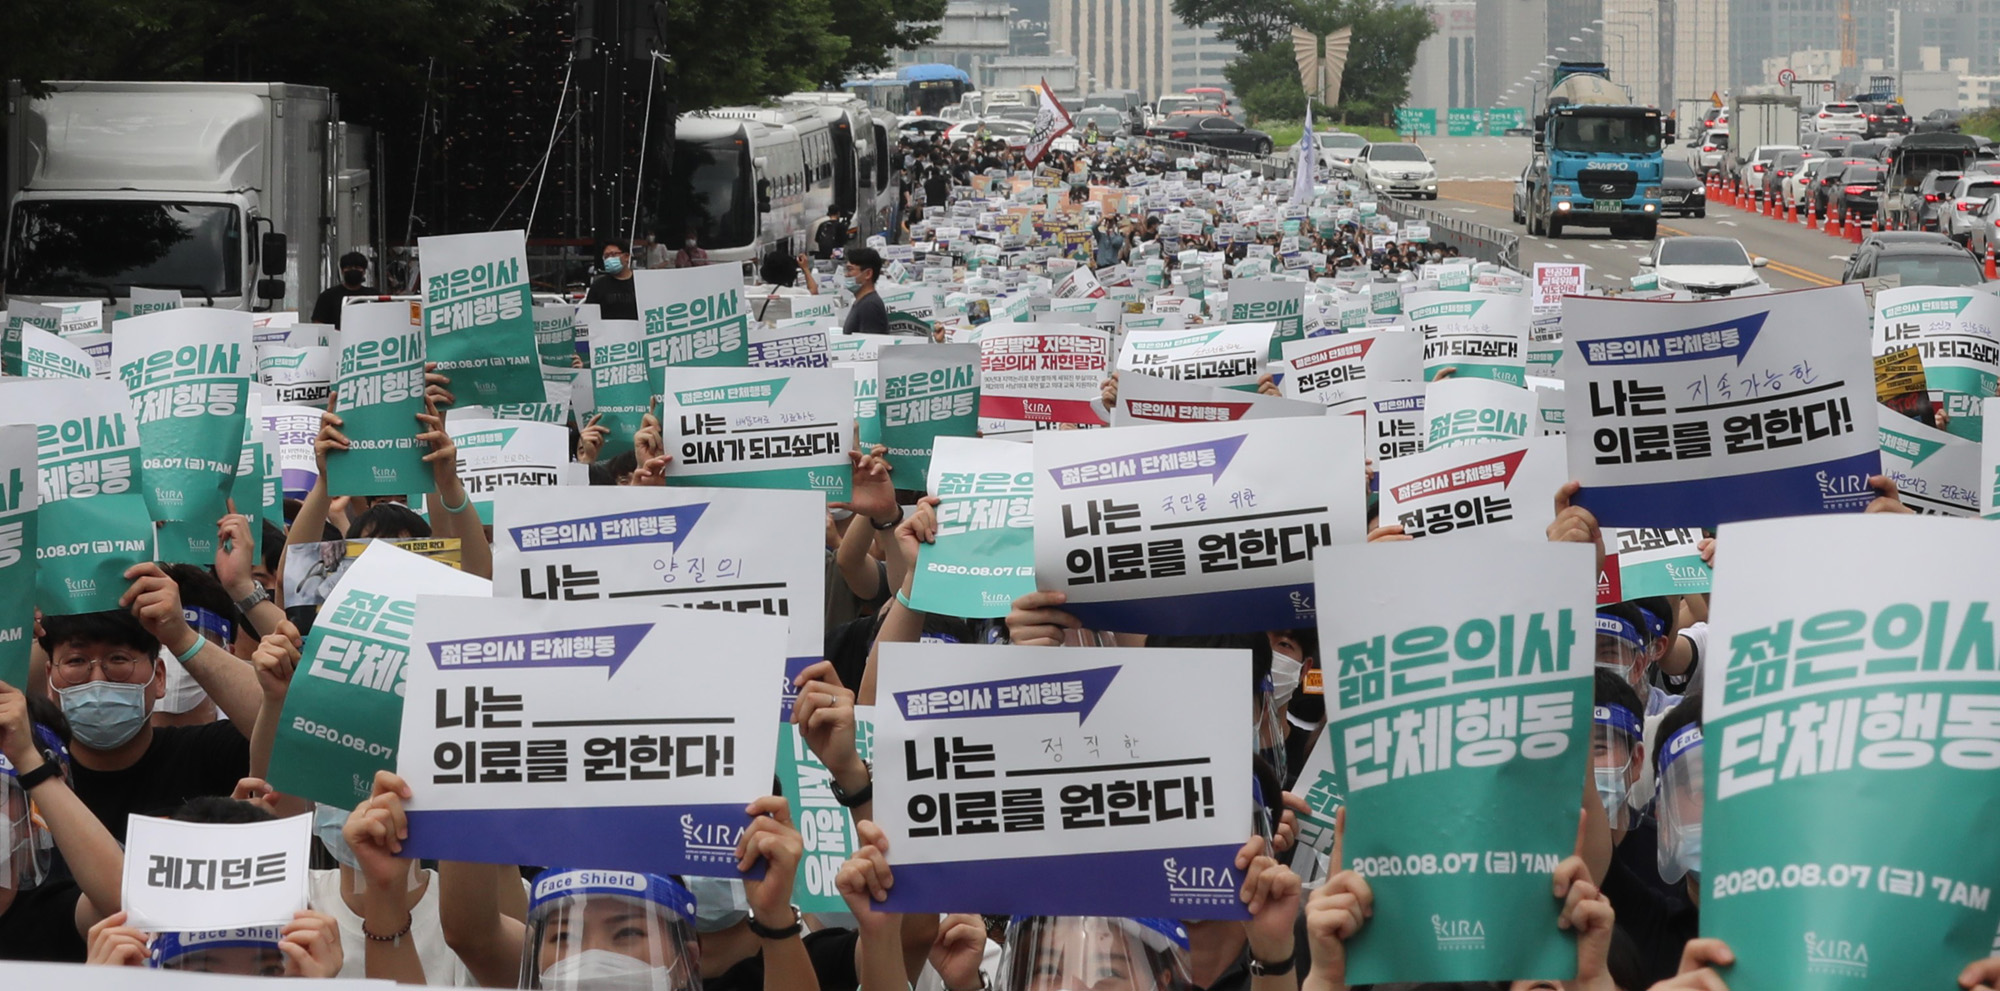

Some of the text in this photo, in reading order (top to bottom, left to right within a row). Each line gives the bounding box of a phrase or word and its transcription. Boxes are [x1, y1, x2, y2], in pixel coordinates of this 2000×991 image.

[1586, 161, 1629, 171] SAMPYO
[428, 257, 519, 303] 젊은의사
[430, 290, 522, 336] 단체행동
[645, 289, 738, 335] 젊은의사
[1232, 299, 1299, 320] 젊은의사
[648, 321, 741, 369] 단체행동
[1043, 336, 1106, 355] 지역논리
[1588, 328, 1740, 363] 젊은의사 단체행동
[1884, 322, 1920, 341] 나는
[341, 331, 422, 376] 젊은의사
[509, 356, 530, 366] 7AM
[1041, 354, 1106, 371] 재현말라
[1132, 353, 1169, 365] 나는
[1451, 340, 1518, 357] 되고싶다!
[119, 343, 241, 390] 젊은의사
[596, 362, 649, 388] 단체행
[885, 364, 974, 399] 젊은의사
[1184, 357, 1257, 380] 되고싶다!
[1297, 364, 1367, 394] 전공의는
[335, 367, 424, 413] 단체행동
[681, 384, 772, 405] 젊은의사 단체행동
[1588, 379, 1667, 417] 나는
[886, 391, 973, 427] 단체행동
[1027, 402, 1052, 412] KIRA
[1132, 401, 1230, 421] 젊은의사 단체행동
[680, 412, 727, 436] 나는
[1378, 418, 1416, 438] 나는
[1429, 408, 1528, 444] 젊은의사
[1593, 396, 1854, 465] 의료를 원한다!
[682, 431, 840, 466] 의사가 되고싶다!
[888, 447, 932, 457] 2020.08.0
[208, 460, 232, 475] 7AM
[814, 475, 843, 487] KIRA
[1061, 448, 1217, 485] 젊은의사 단체행동
[1398, 461, 1507, 501] 젊은의사 단체행동
[1828, 473, 1871, 494] KIRA
[1161, 488, 1258, 514] 국민을 위한
[1397, 496, 1513, 539] 전공의는
[520, 514, 677, 549] 젊은의사 단체행동
[1061, 497, 1142, 539] 나는
[92, 540, 113, 553] (금)
[116, 540, 146, 552] 7AM
[1066, 522, 1332, 586] 의료를 원한다!
[1616, 528, 1694, 555] 고싶다!
[520, 563, 601, 601] 나는
[927, 562, 1014, 577] 2020.08.07
[1674, 566, 1708, 577] KIRA
[440, 635, 616, 666] 젊은의사 단체행동
[1337, 608, 1576, 711] 젊은의사
[435, 686, 524, 729] 나는
[906, 680, 1084, 717] 젊은의사 단체행동
[292, 716, 393, 760] 2020.08.07
[1343, 690, 1574, 793] 단체행동
[1716, 691, 2000, 801] 단체행동
[433, 735, 735, 785] 의료를 원한다!
[904, 736, 996, 782] 나는
[907, 775, 1215, 838] 의료를 원한다!
[693, 823, 745, 846] KIRA
[147, 851, 287, 891] 레지던트
[1177, 866, 1235, 887] KIRA
[1352, 850, 1559, 878] 2020.08.07 (금) 7AM
[541, 871, 635, 892] Face Shield
[1713, 863, 1991, 911] 2020.08.07 (금) 7AM
[1440, 918, 1486, 937] KIRA
[1813, 940, 1869, 963] KIRA
